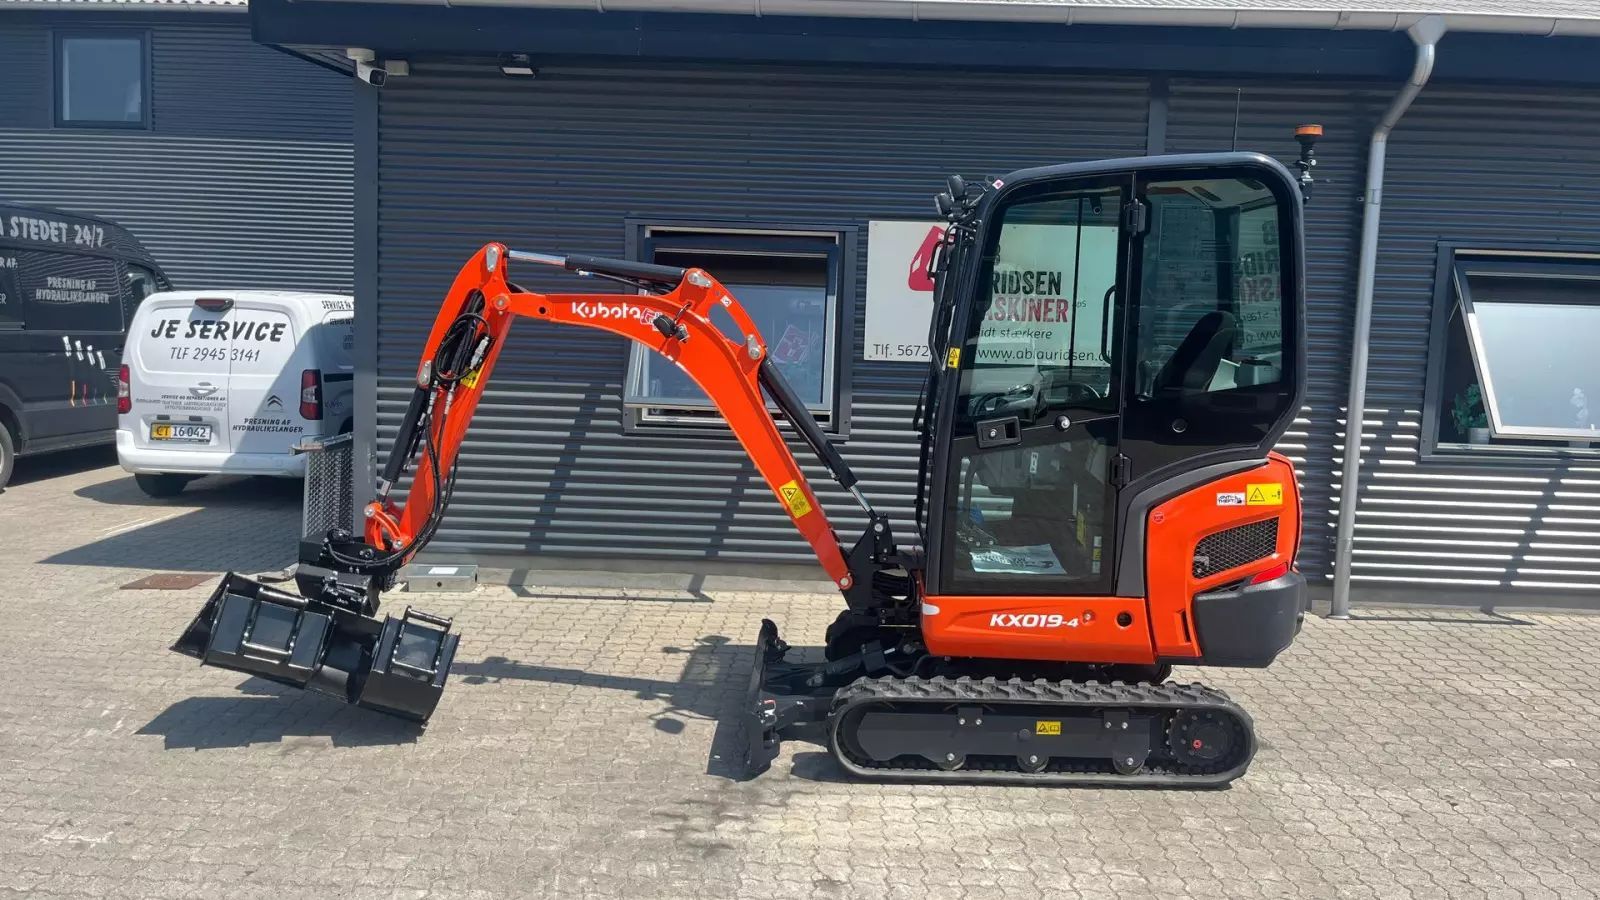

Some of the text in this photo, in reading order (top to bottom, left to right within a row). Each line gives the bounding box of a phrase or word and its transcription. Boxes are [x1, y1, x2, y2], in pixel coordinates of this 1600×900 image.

[10, 216, 67, 243] STEDET
[74, 224, 104, 248] 24/7
[47, 277, 96, 290] PRESNING AF
[36, 289, 110, 304] HYDRAULIKSLANGER
[572, 302, 640, 318] Kubota
[151, 320, 286, 342] JE SERVICE
[1000, 327, 1053, 339] stærkere
[171, 347, 260, 361] TLF 2945 3141
[873, 344, 929, 358] Tlf. 5672
[244, 417, 279, 426] PRESNING
[156, 426, 169, 436] CT
[233, 424, 304, 434] HYDRAULIKSLANGER
[989, 613, 1079, 628] KX019-4
